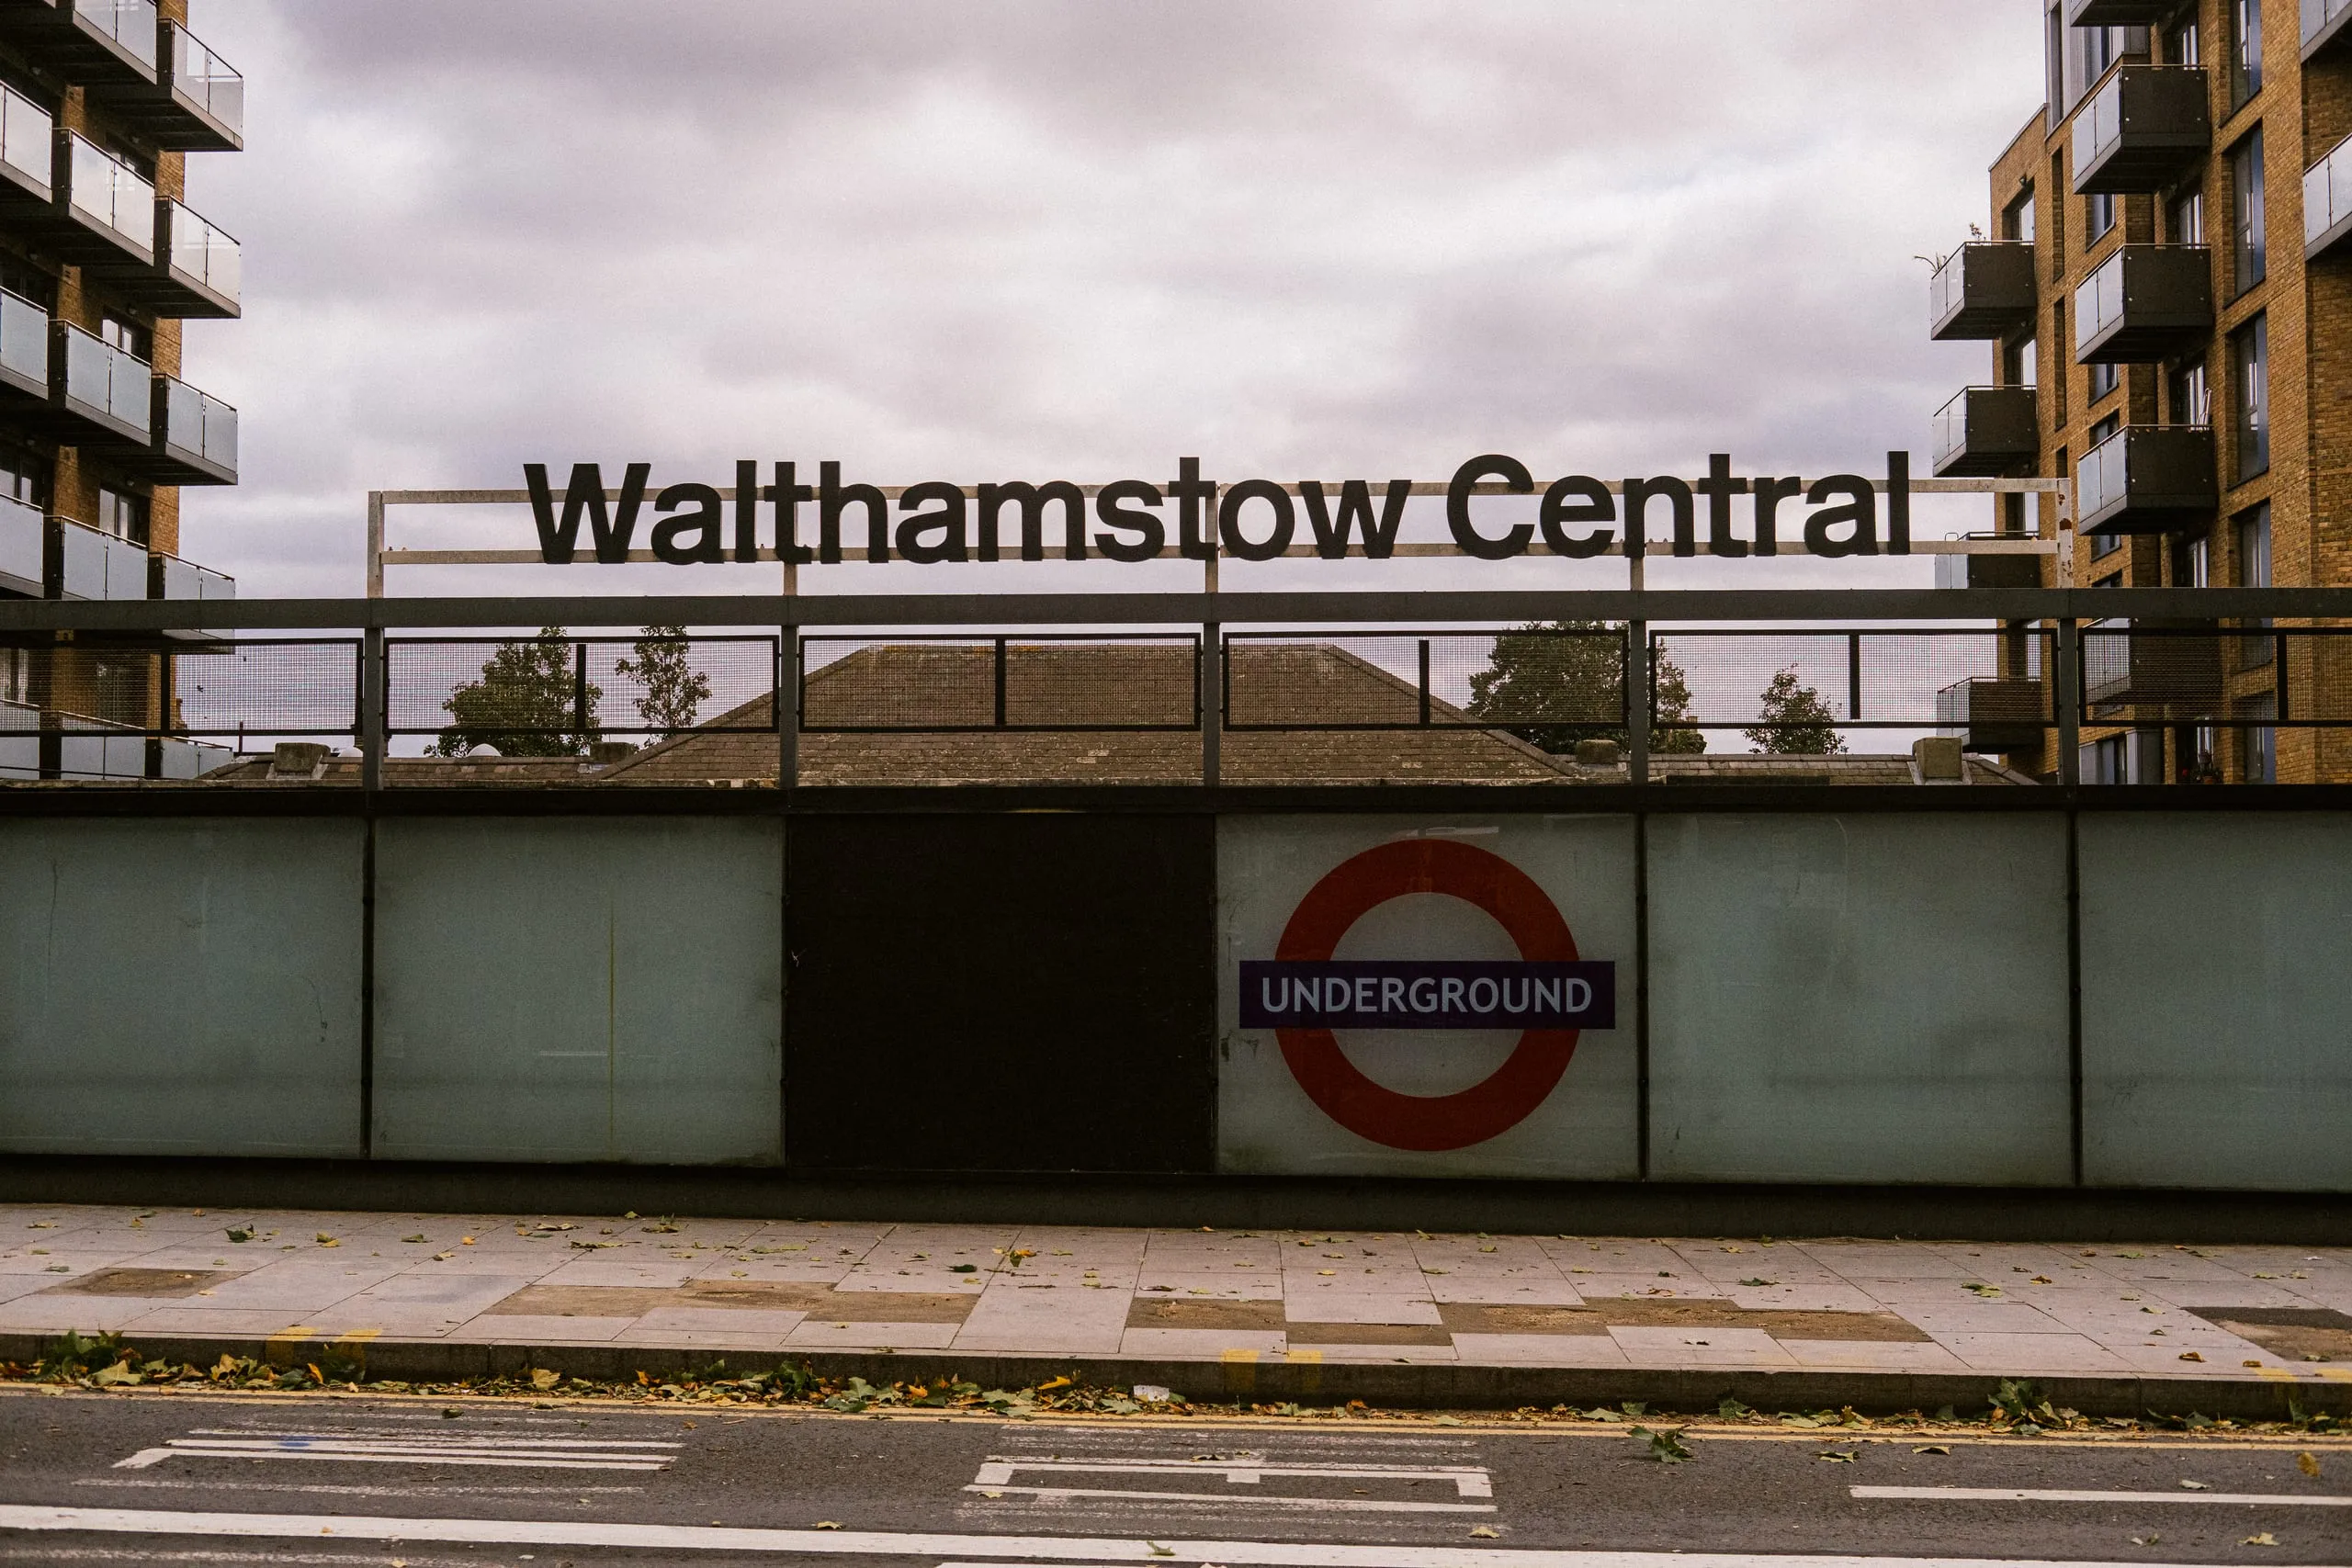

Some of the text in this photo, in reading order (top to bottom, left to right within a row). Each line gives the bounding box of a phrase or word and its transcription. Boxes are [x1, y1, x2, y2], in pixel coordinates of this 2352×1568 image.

[523, 451, 1912, 566] Walthamstow Central
[1261, 976, 1592, 1014] UNDERGROUND
